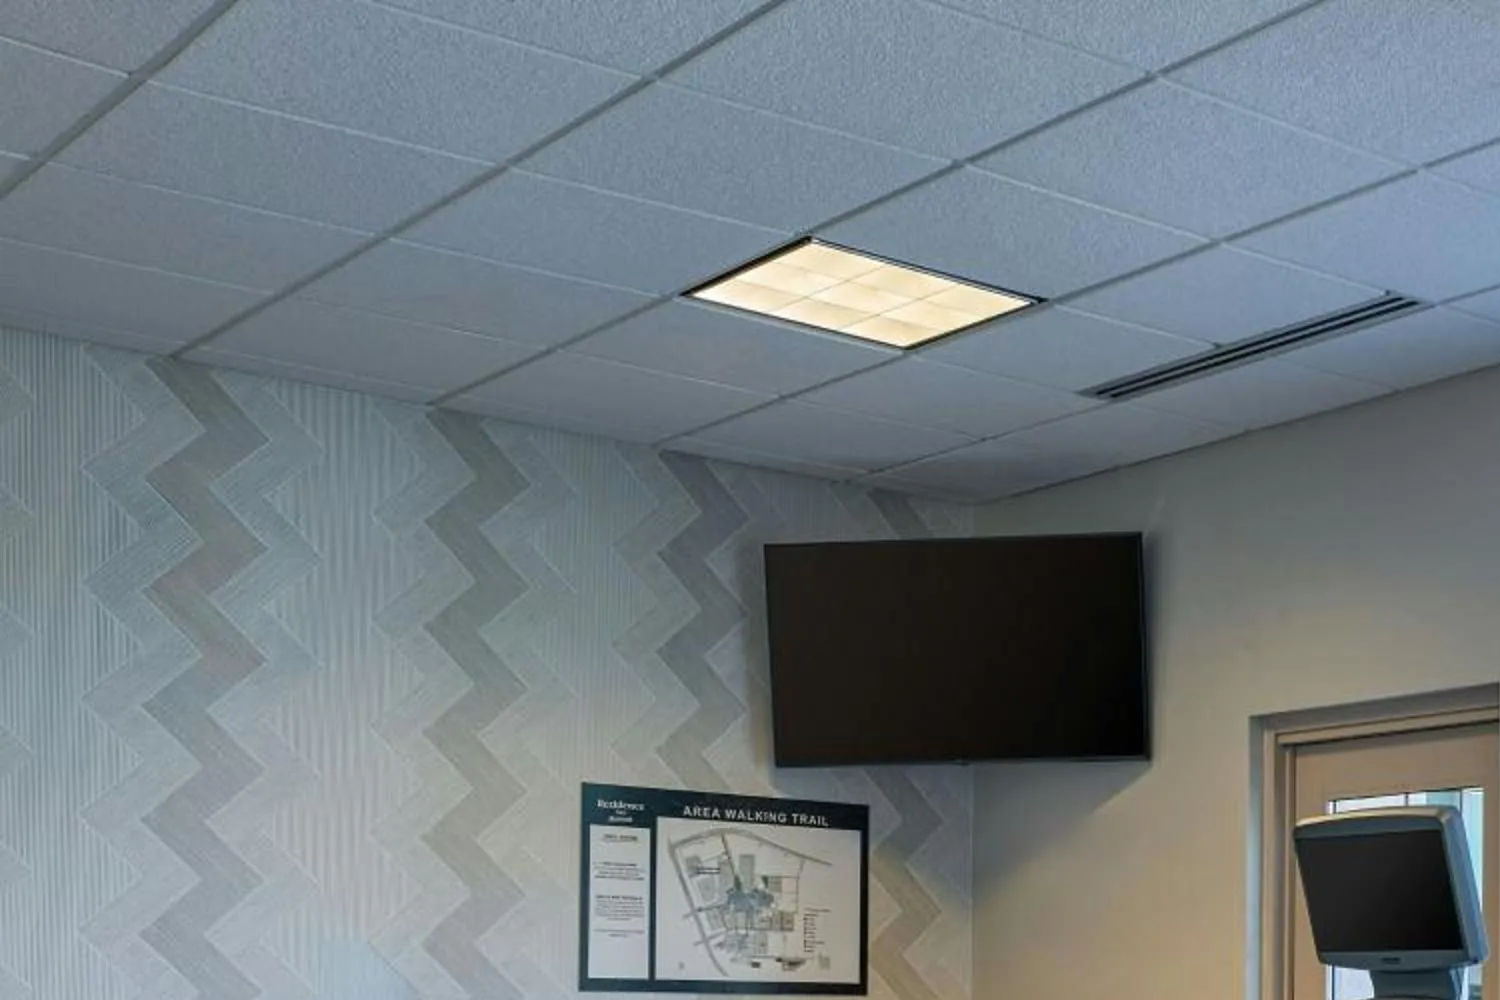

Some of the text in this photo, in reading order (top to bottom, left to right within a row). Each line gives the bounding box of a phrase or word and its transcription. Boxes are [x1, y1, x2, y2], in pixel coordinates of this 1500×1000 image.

[682, 805, 829, 827] AREA WALKING TRAIL
